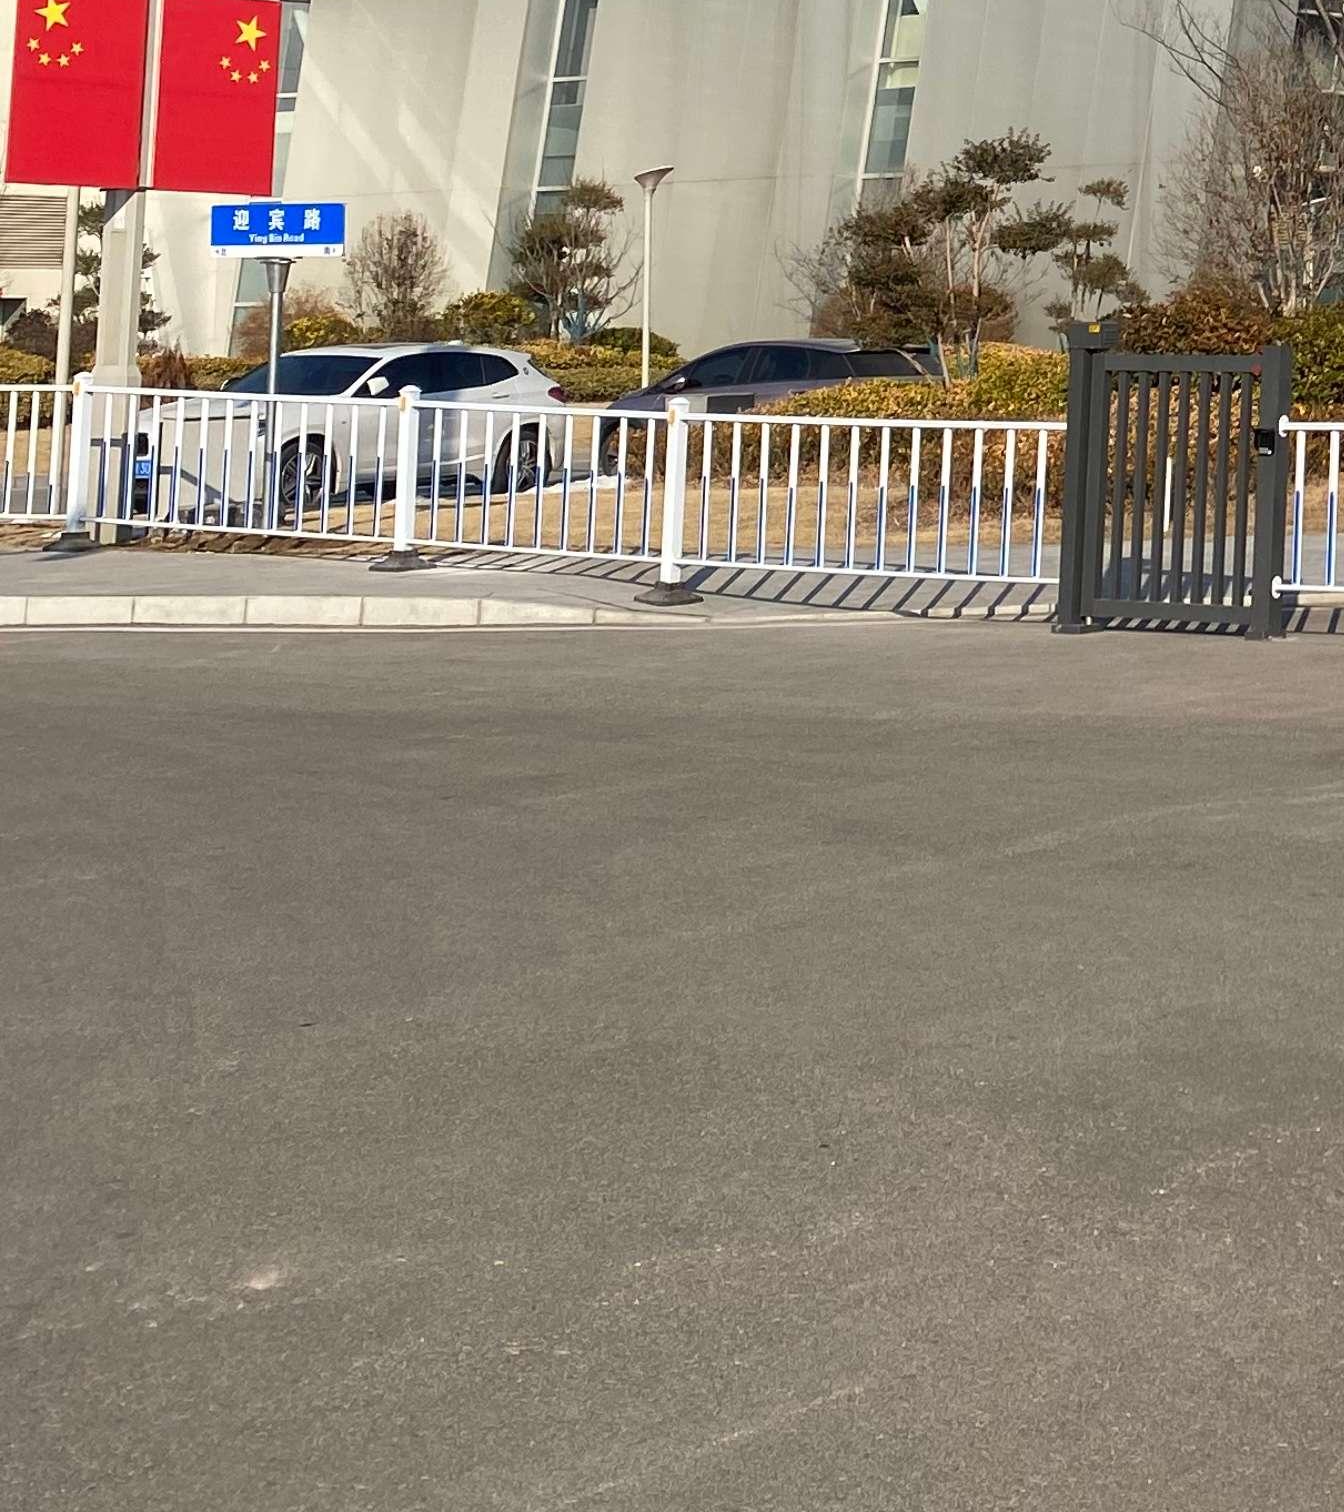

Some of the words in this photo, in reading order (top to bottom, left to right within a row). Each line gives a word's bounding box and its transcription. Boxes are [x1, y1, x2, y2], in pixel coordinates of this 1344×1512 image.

[232, 208, 321, 231] 迎宾路
[283, 232, 305, 243] Road
